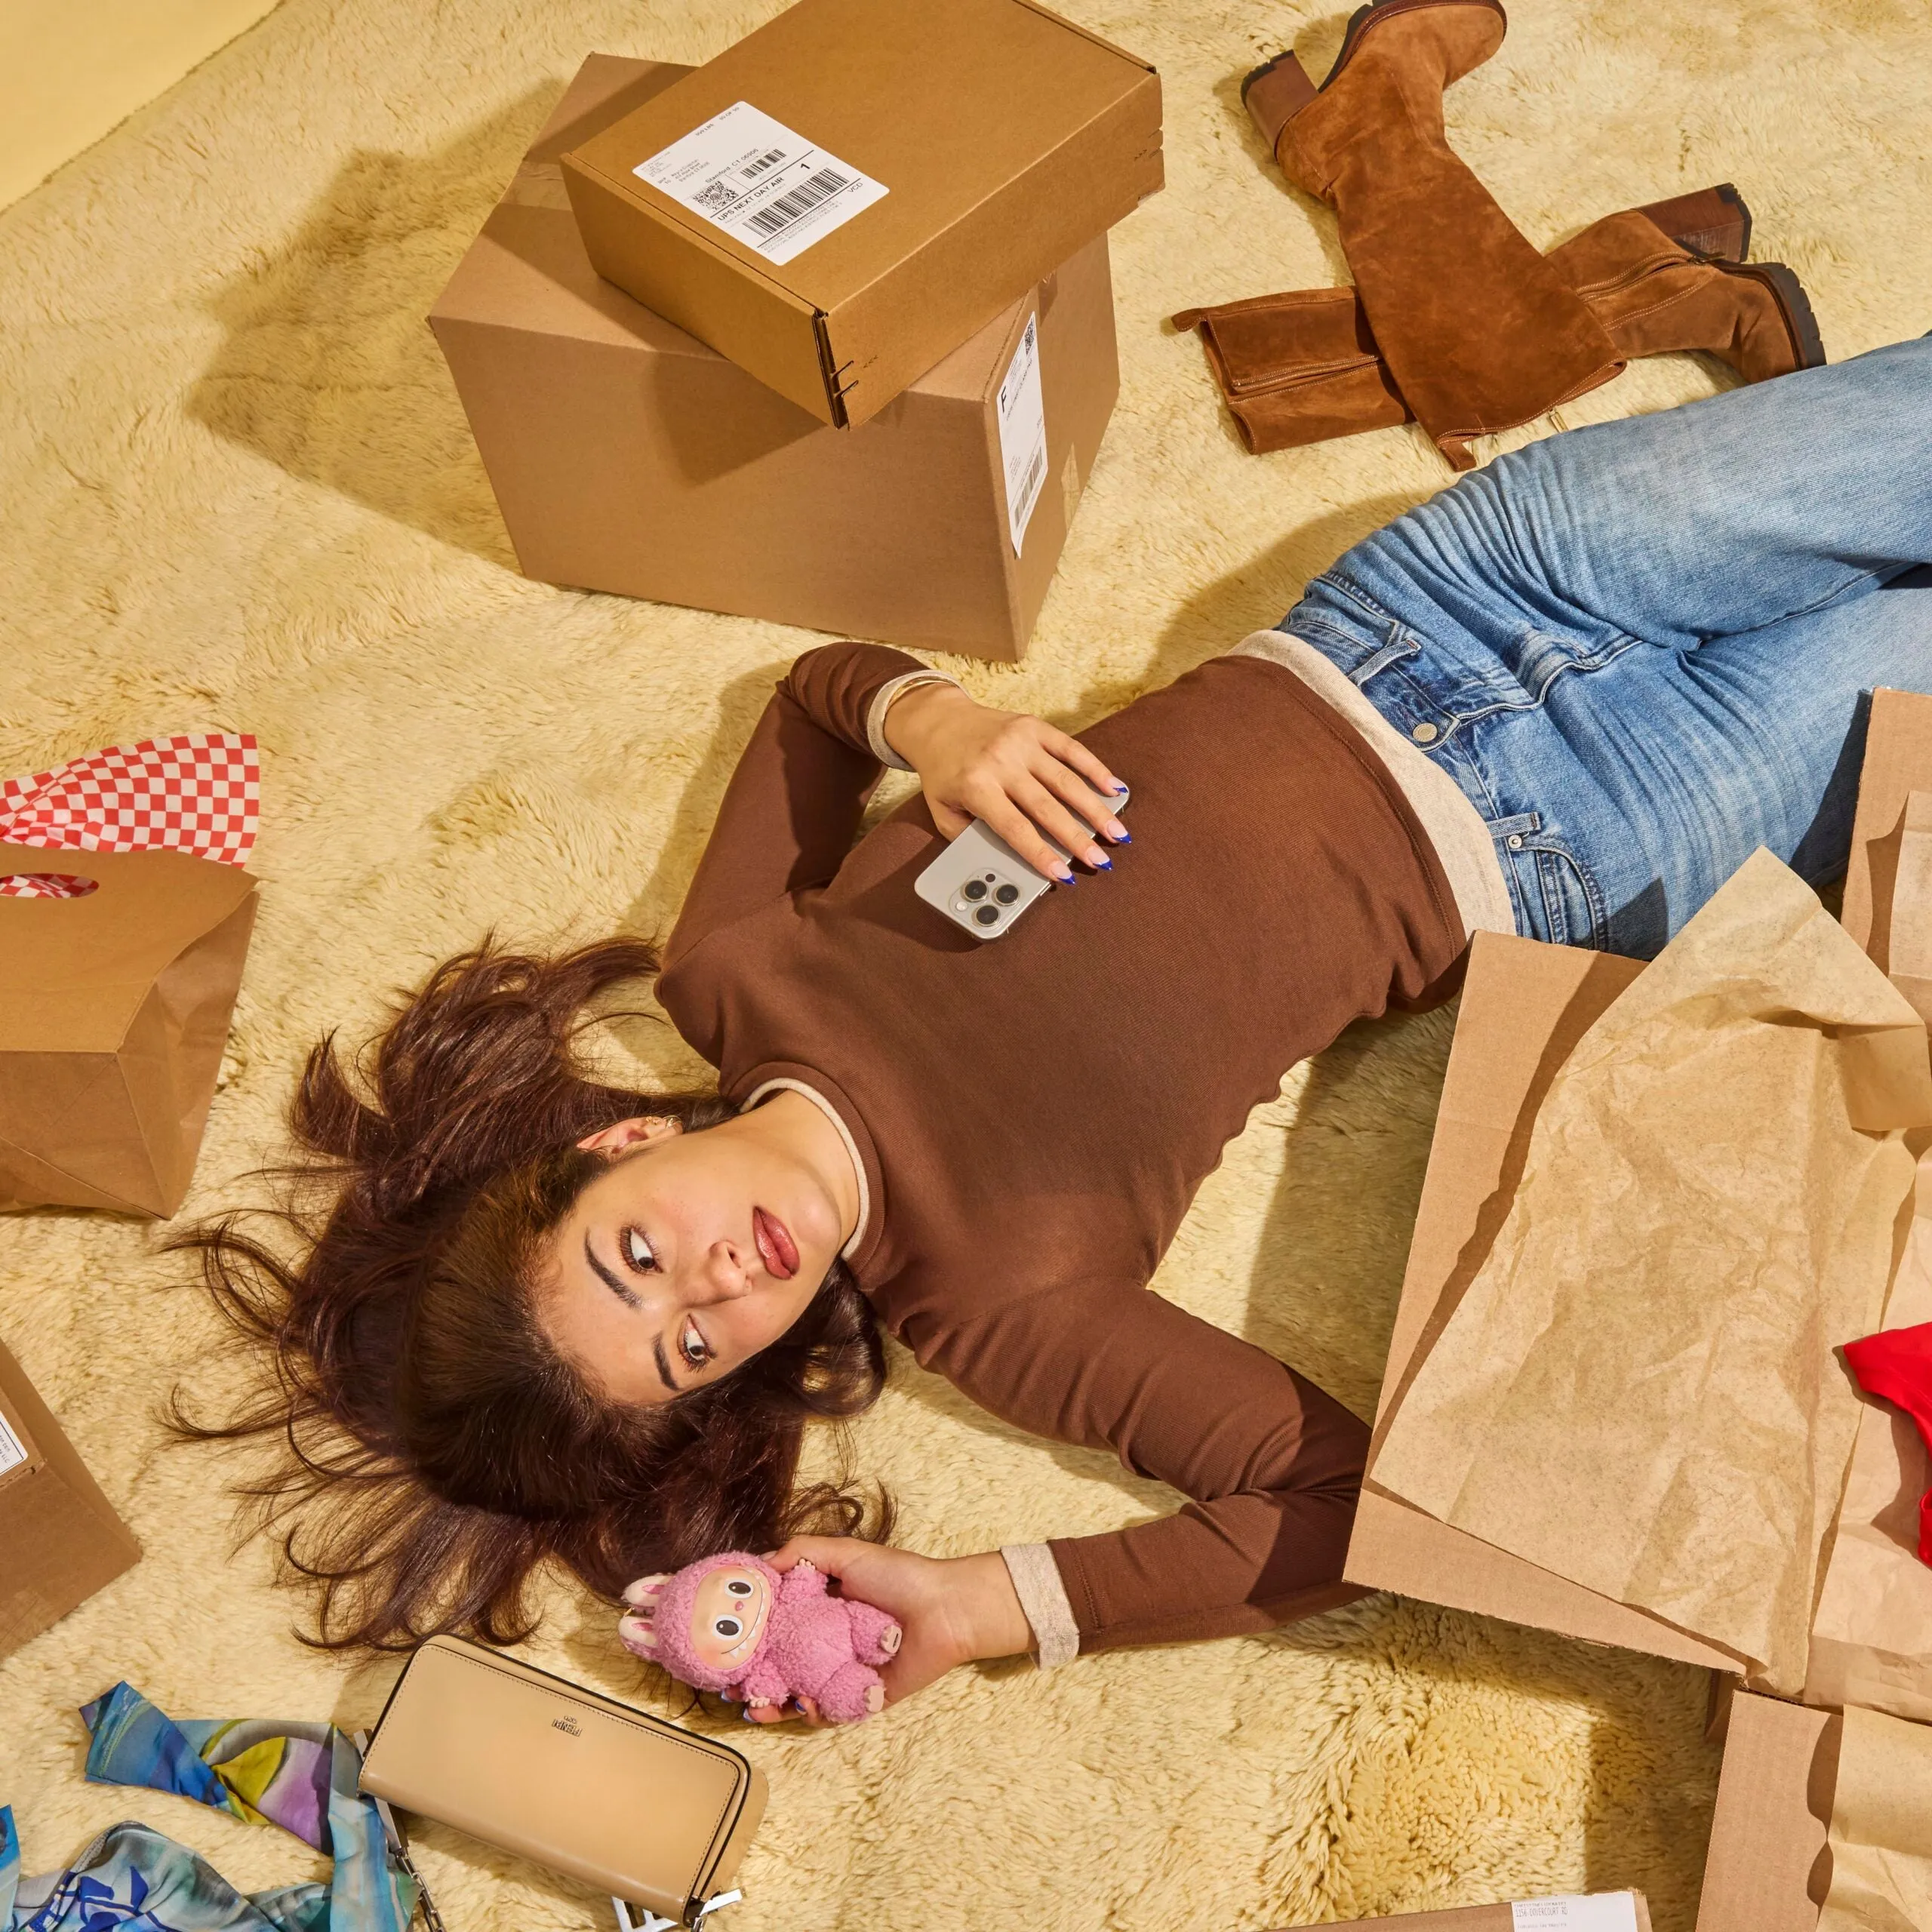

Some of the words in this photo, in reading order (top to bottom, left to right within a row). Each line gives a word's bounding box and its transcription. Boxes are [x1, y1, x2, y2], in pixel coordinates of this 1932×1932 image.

[705, 167, 731, 183] Stamford
[718, 210, 735, 220] UPS
[734, 196, 755, 211] NEXT
[753, 186, 771, 197] DAY
[770, 177, 784, 186] AIR
[1001, 386, 1007, 413] F
